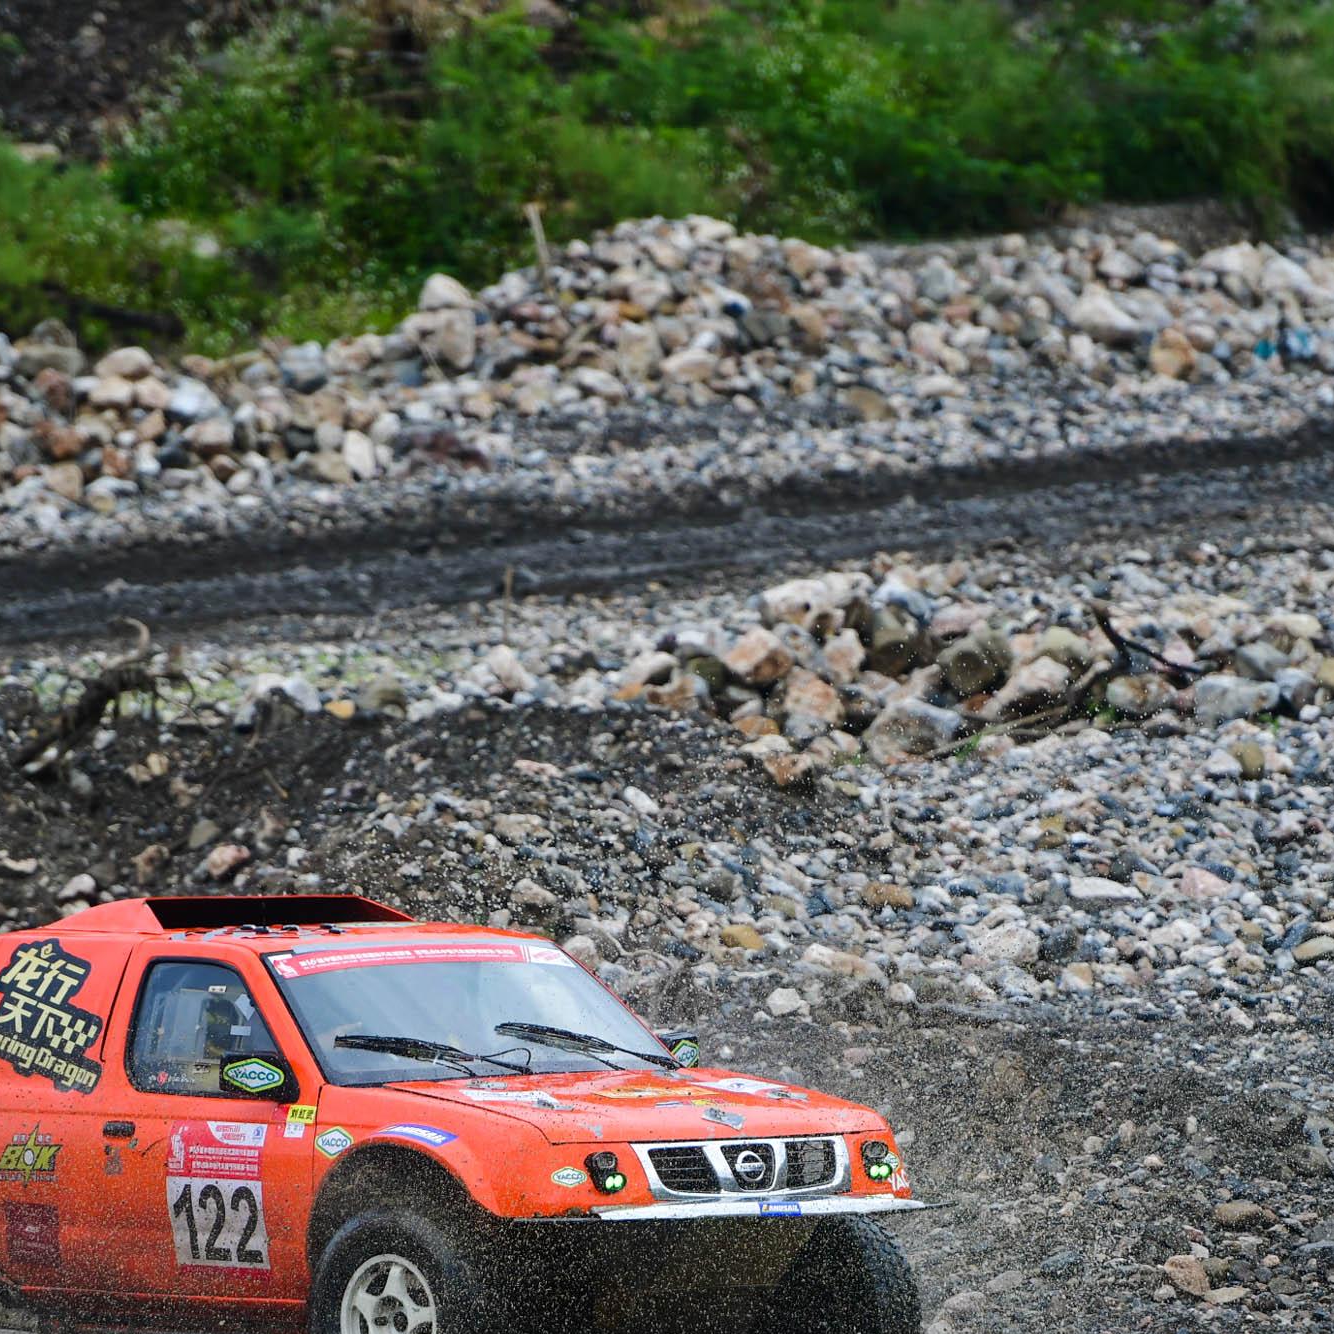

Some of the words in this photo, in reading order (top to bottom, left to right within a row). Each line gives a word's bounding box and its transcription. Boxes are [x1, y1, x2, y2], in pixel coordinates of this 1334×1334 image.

[35, 1047, 97, 1087] Dragon
[233, 1069, 275, 1082] YACCO
[321, 1137, 348, 1149] YACCO
[173, 1184, 264, 1263] 122
